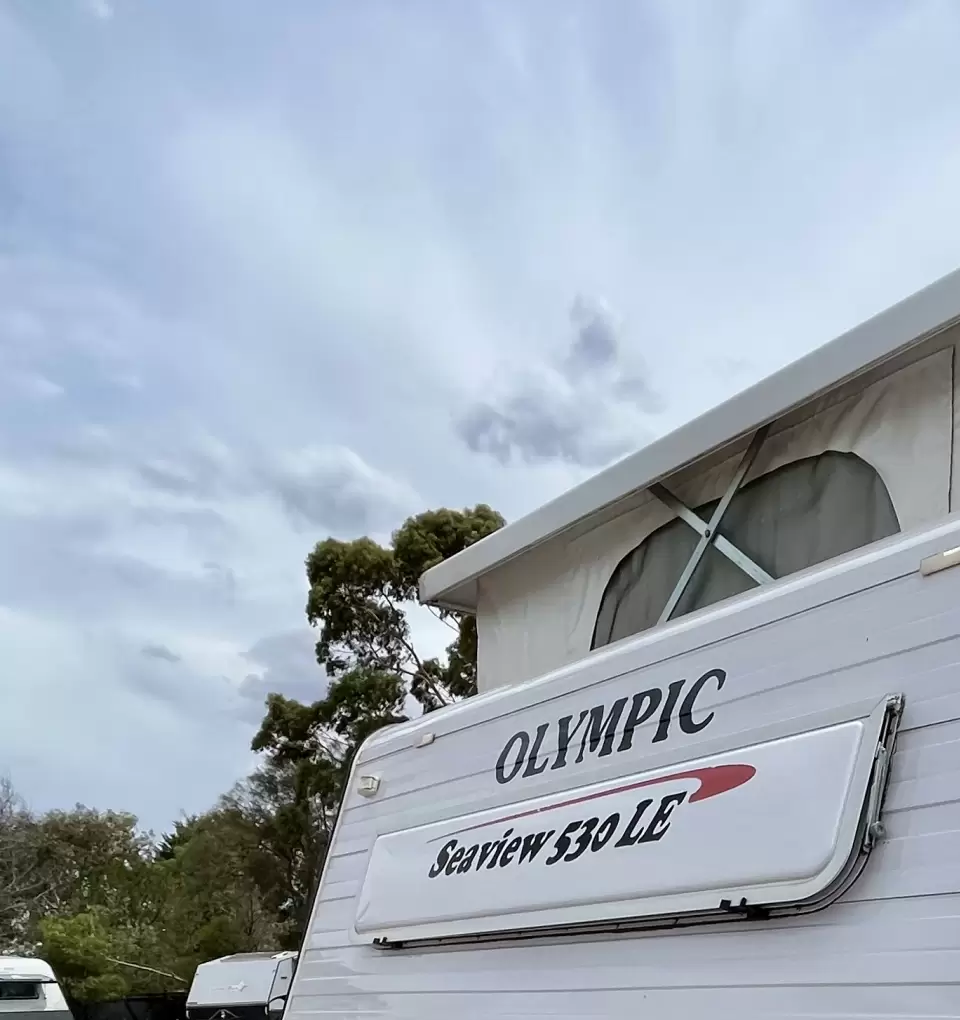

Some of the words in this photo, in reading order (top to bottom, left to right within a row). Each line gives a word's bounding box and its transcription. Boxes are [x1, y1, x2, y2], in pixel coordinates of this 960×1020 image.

[495, 668, 727, 784] OLYMPIC
[428, 828, 554, 879] Seaview
[546, 812, 620, 866] 530
[614, 791, 688, 848] LE
